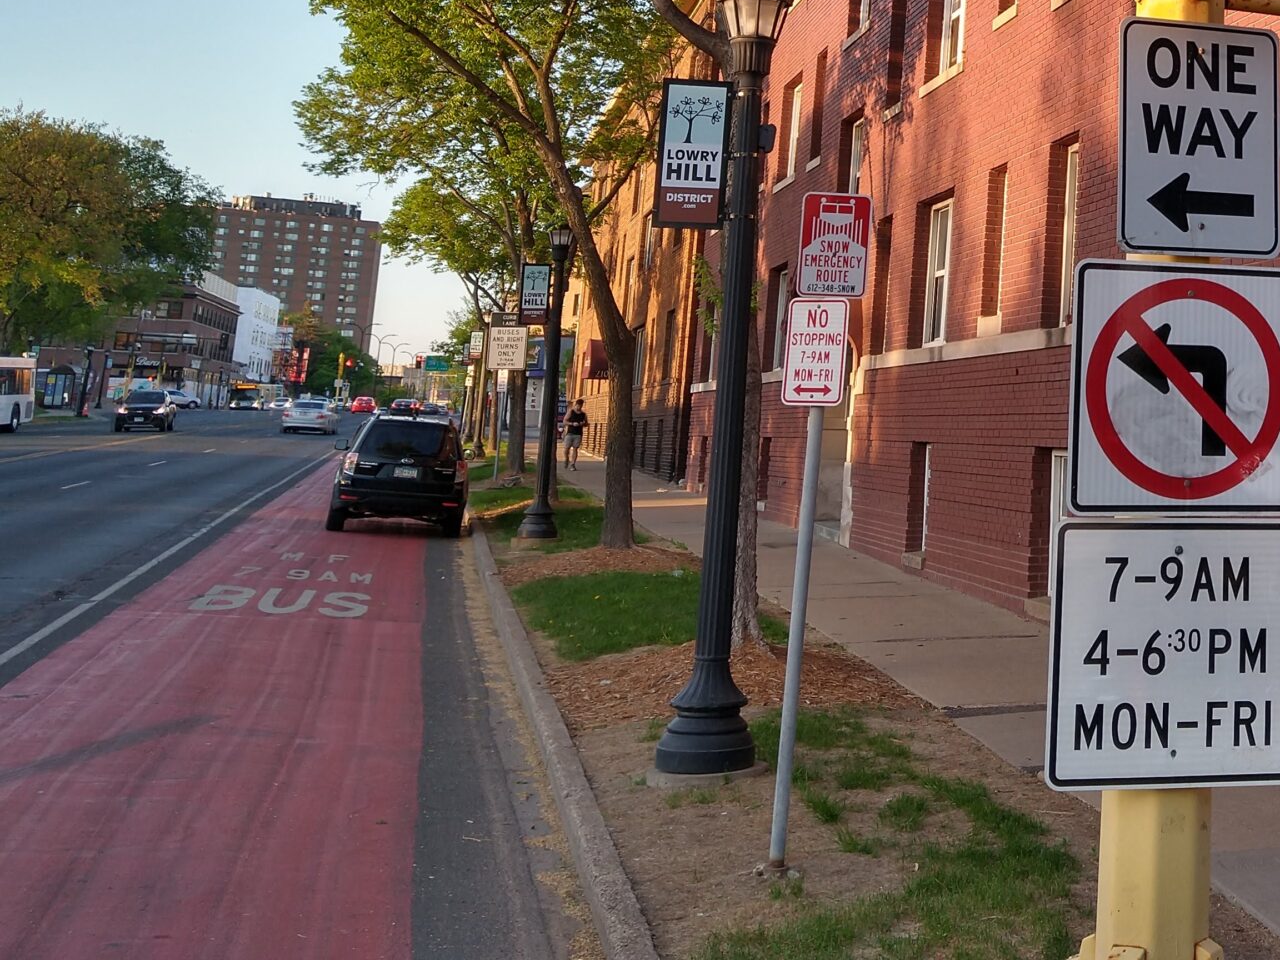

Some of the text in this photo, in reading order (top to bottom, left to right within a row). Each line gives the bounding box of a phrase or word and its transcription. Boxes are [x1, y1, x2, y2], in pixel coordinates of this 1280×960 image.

[1146, 37, 1258, 96] ONE
[1142, 103, 1258, 160] WAY
[666, 148, 719, 162] LOWRY
[665, 162, 717, 182] HILL
[666, 192, 714, 204] DISTRICT
[820, 240, 850, 254] SNOW
[804, 253, 863, 269] EMERGENCY
[816, 269, 850, 283] ROUTE
[806, 283, 857, 294] 612-348-SNOW
[523, 297, 545, 306] HILL
[807, 309, 829, 329] NO
[791, 332, 842, 346] STOPPING
[800, 350, 831, 364] 7-9AM
[793, 368, 834, 382] MON-FRI
[1105, 556, 1250, 602] 7-9AM
[188, 584, 372, 618] BUS
[1073, 700, 1272, 751] MON-FRI
